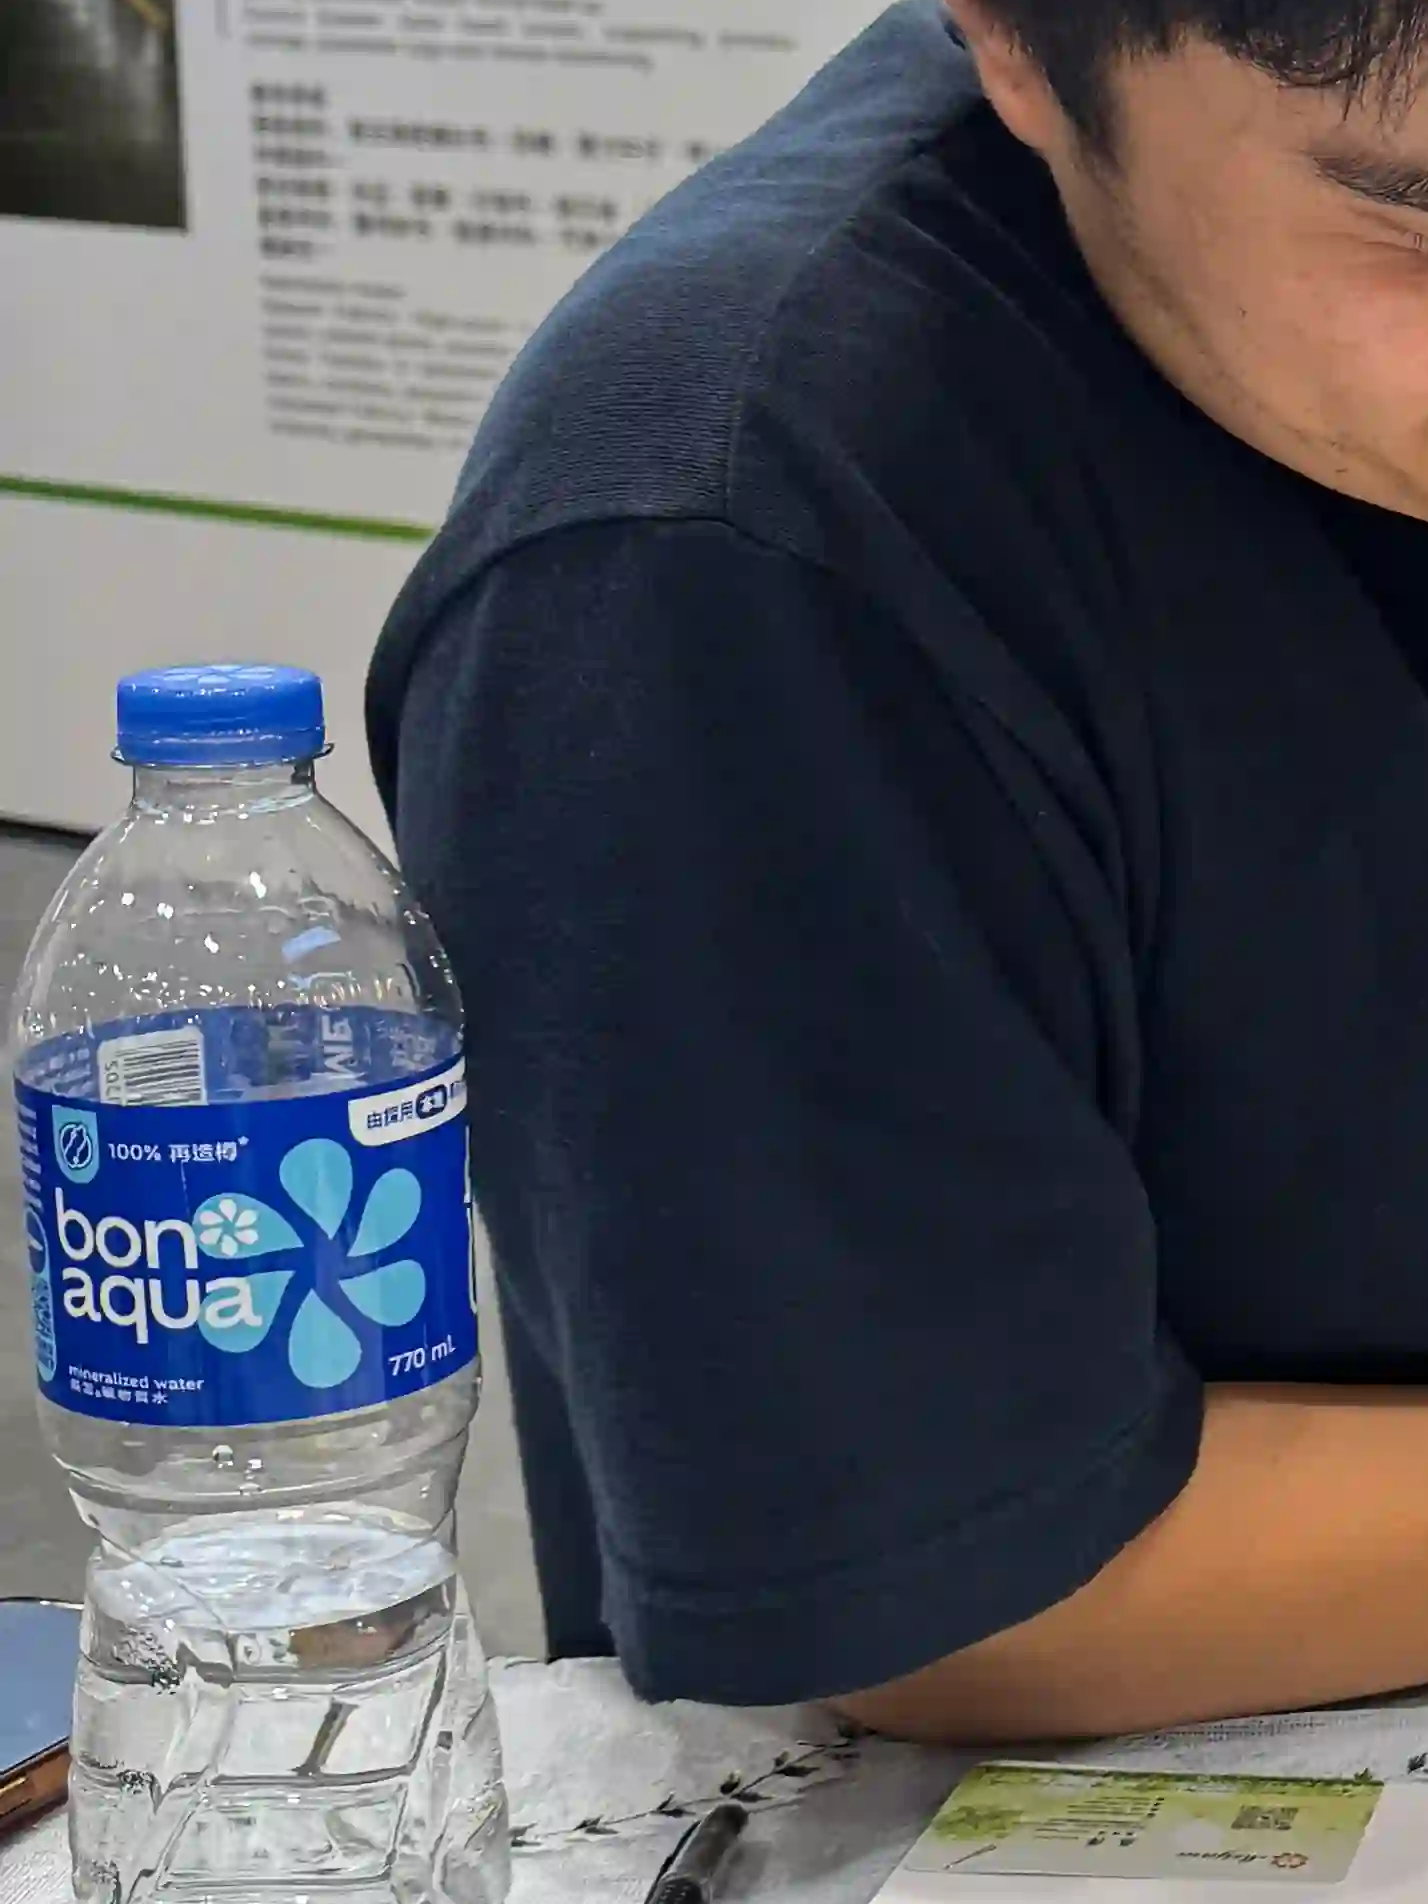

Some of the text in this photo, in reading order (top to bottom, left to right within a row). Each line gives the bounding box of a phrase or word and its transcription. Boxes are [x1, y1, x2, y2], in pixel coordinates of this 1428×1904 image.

[108, 1142, 162, 1162] 100%
[55, 1186, 199, 1272] bon
[62, 1265, 263, 1345] aqua
[388, 1334, 457, 1377] 770 mL
[68, 1363, 205, 1393] mineralized water
